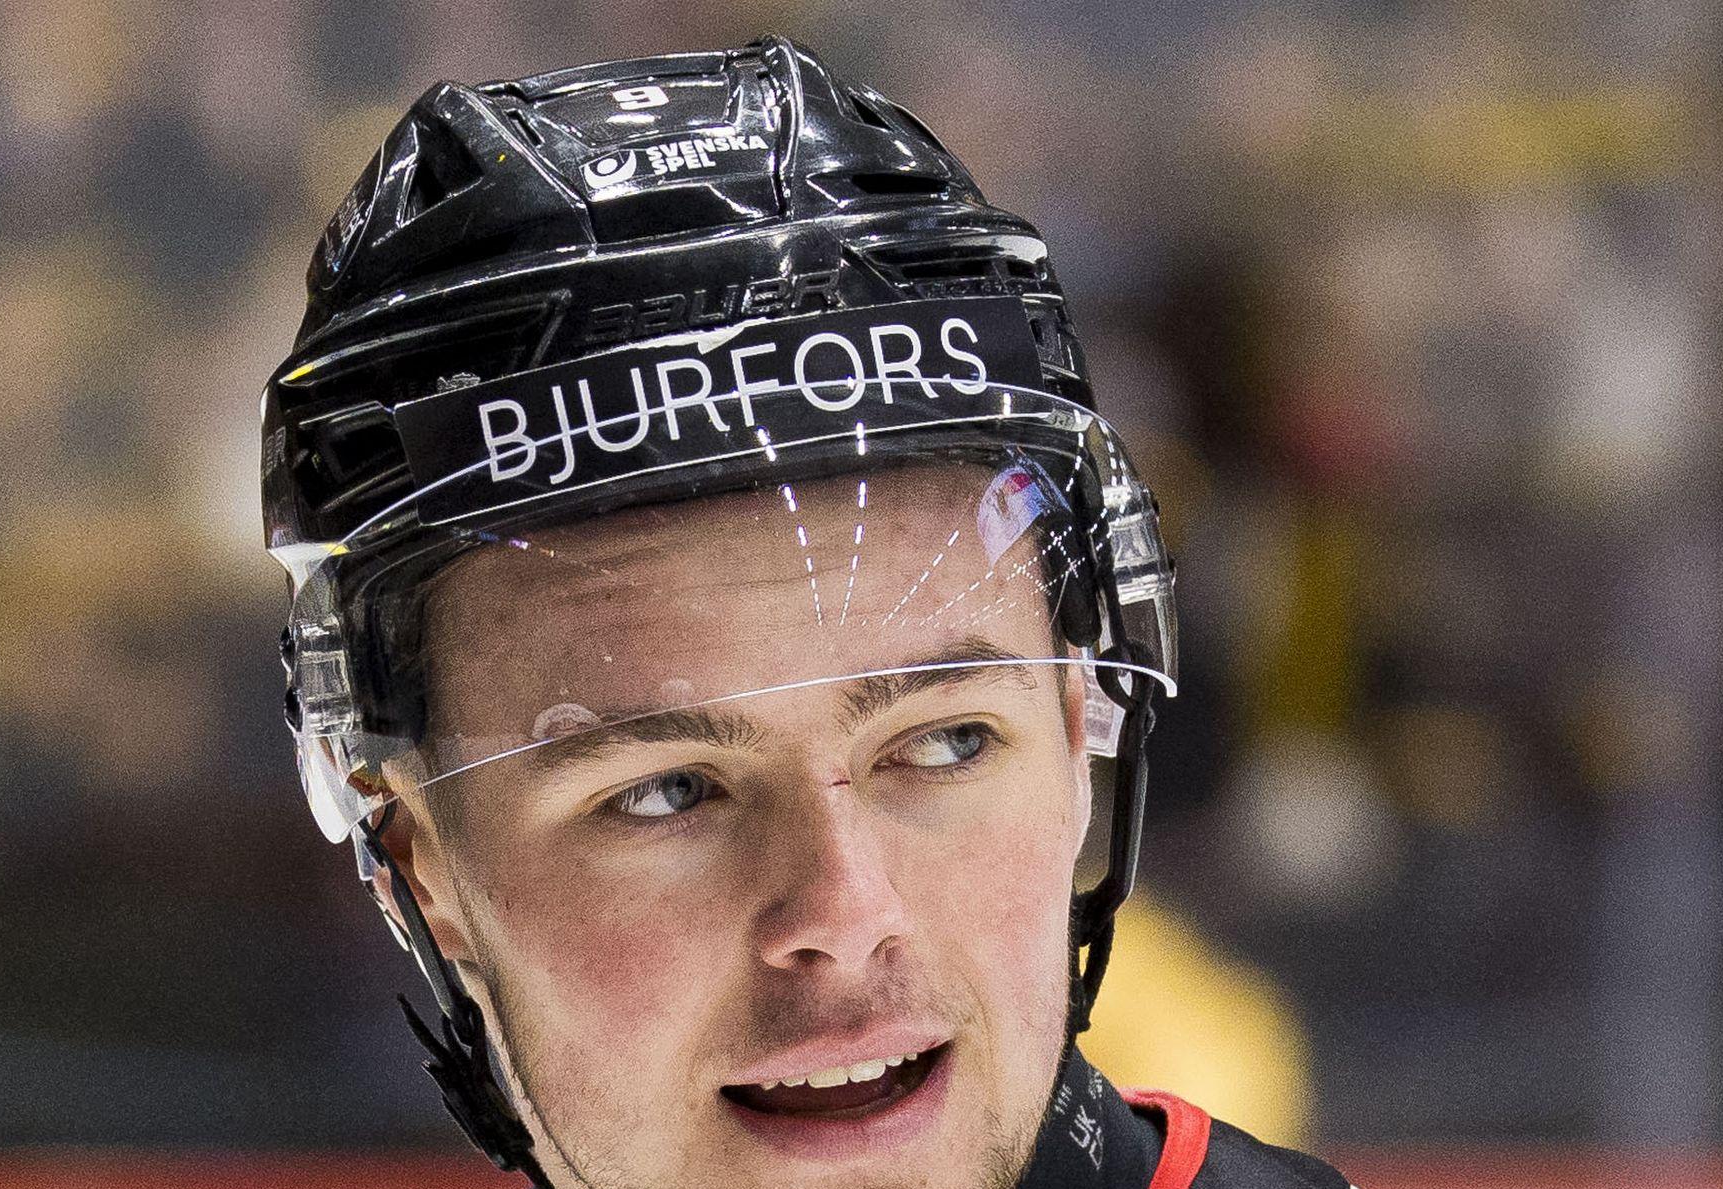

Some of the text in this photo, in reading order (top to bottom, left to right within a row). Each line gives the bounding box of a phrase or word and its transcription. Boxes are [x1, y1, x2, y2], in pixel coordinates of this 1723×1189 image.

[612, 86, 670, 111] 9
[646, 135, 768, 162] SVENSKA
[650, 150, 716, 176] SPEL
[478, 317, 988, 485] BJURFORS
